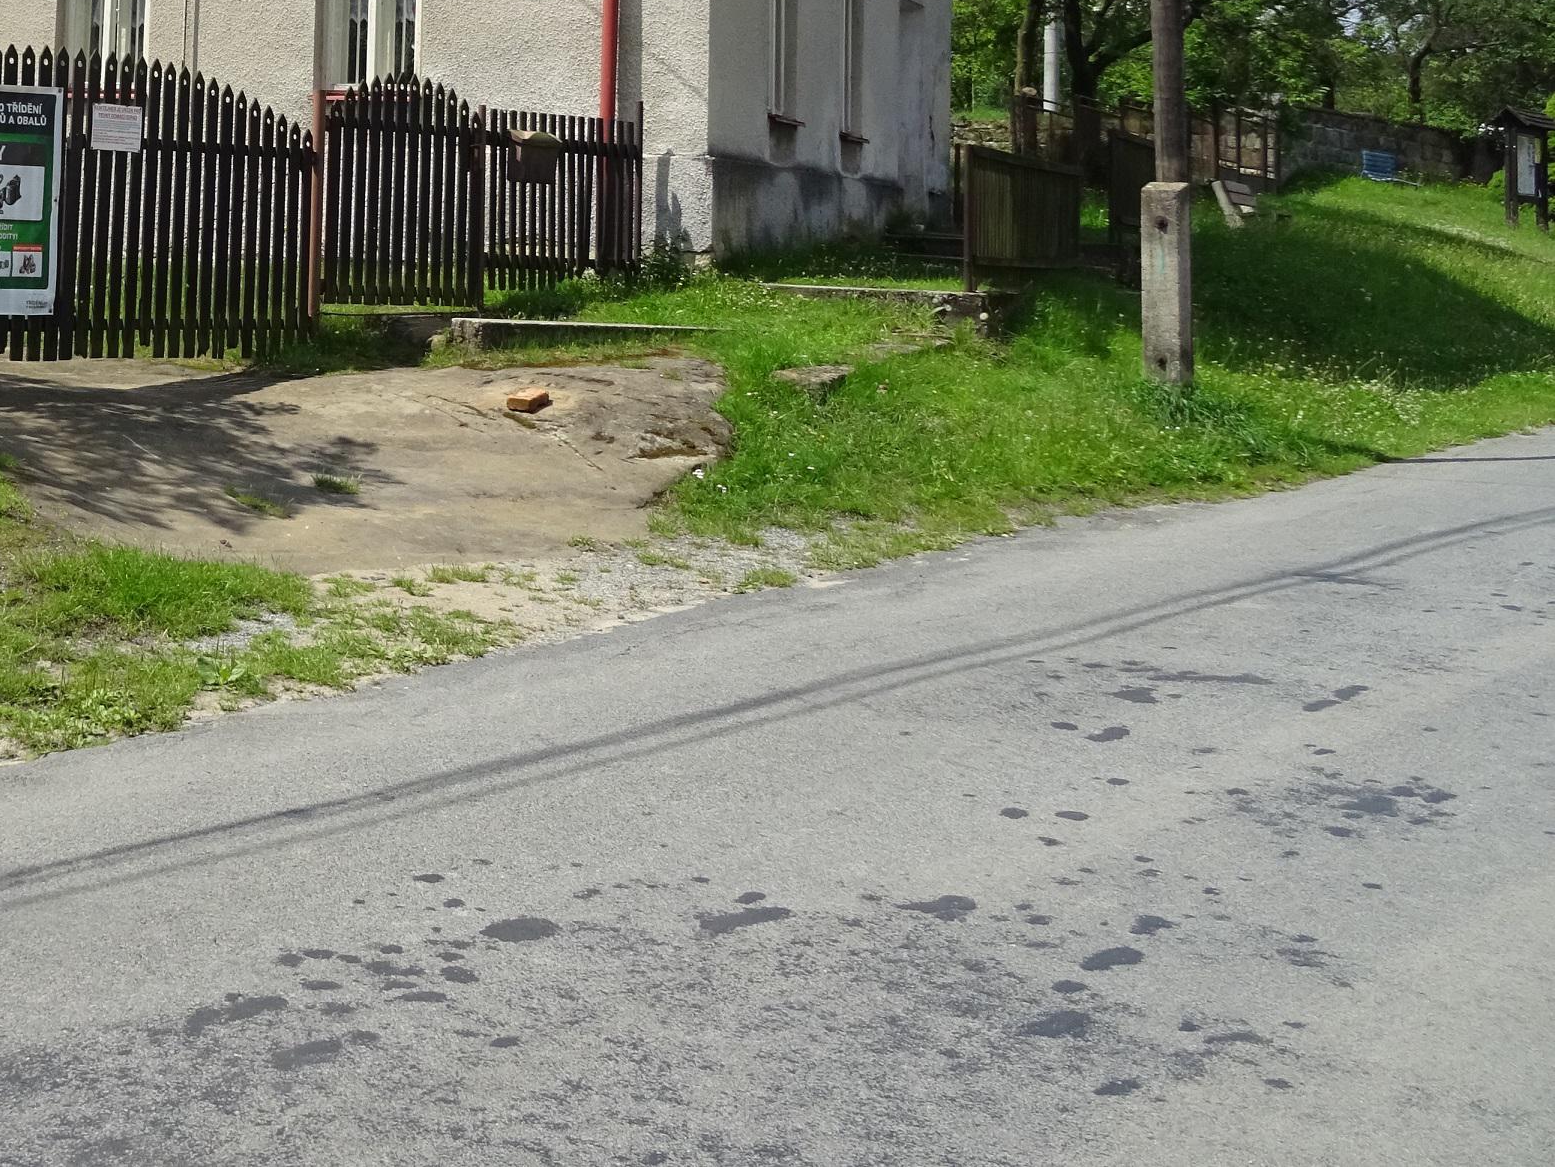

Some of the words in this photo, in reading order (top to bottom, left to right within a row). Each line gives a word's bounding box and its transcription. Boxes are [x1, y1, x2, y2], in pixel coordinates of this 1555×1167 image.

[7, 102, 42, 114] TŘÍDĚNÍ
[8, 116, 15, 124] A
[17, 115, 46, 126] OBALŮ
